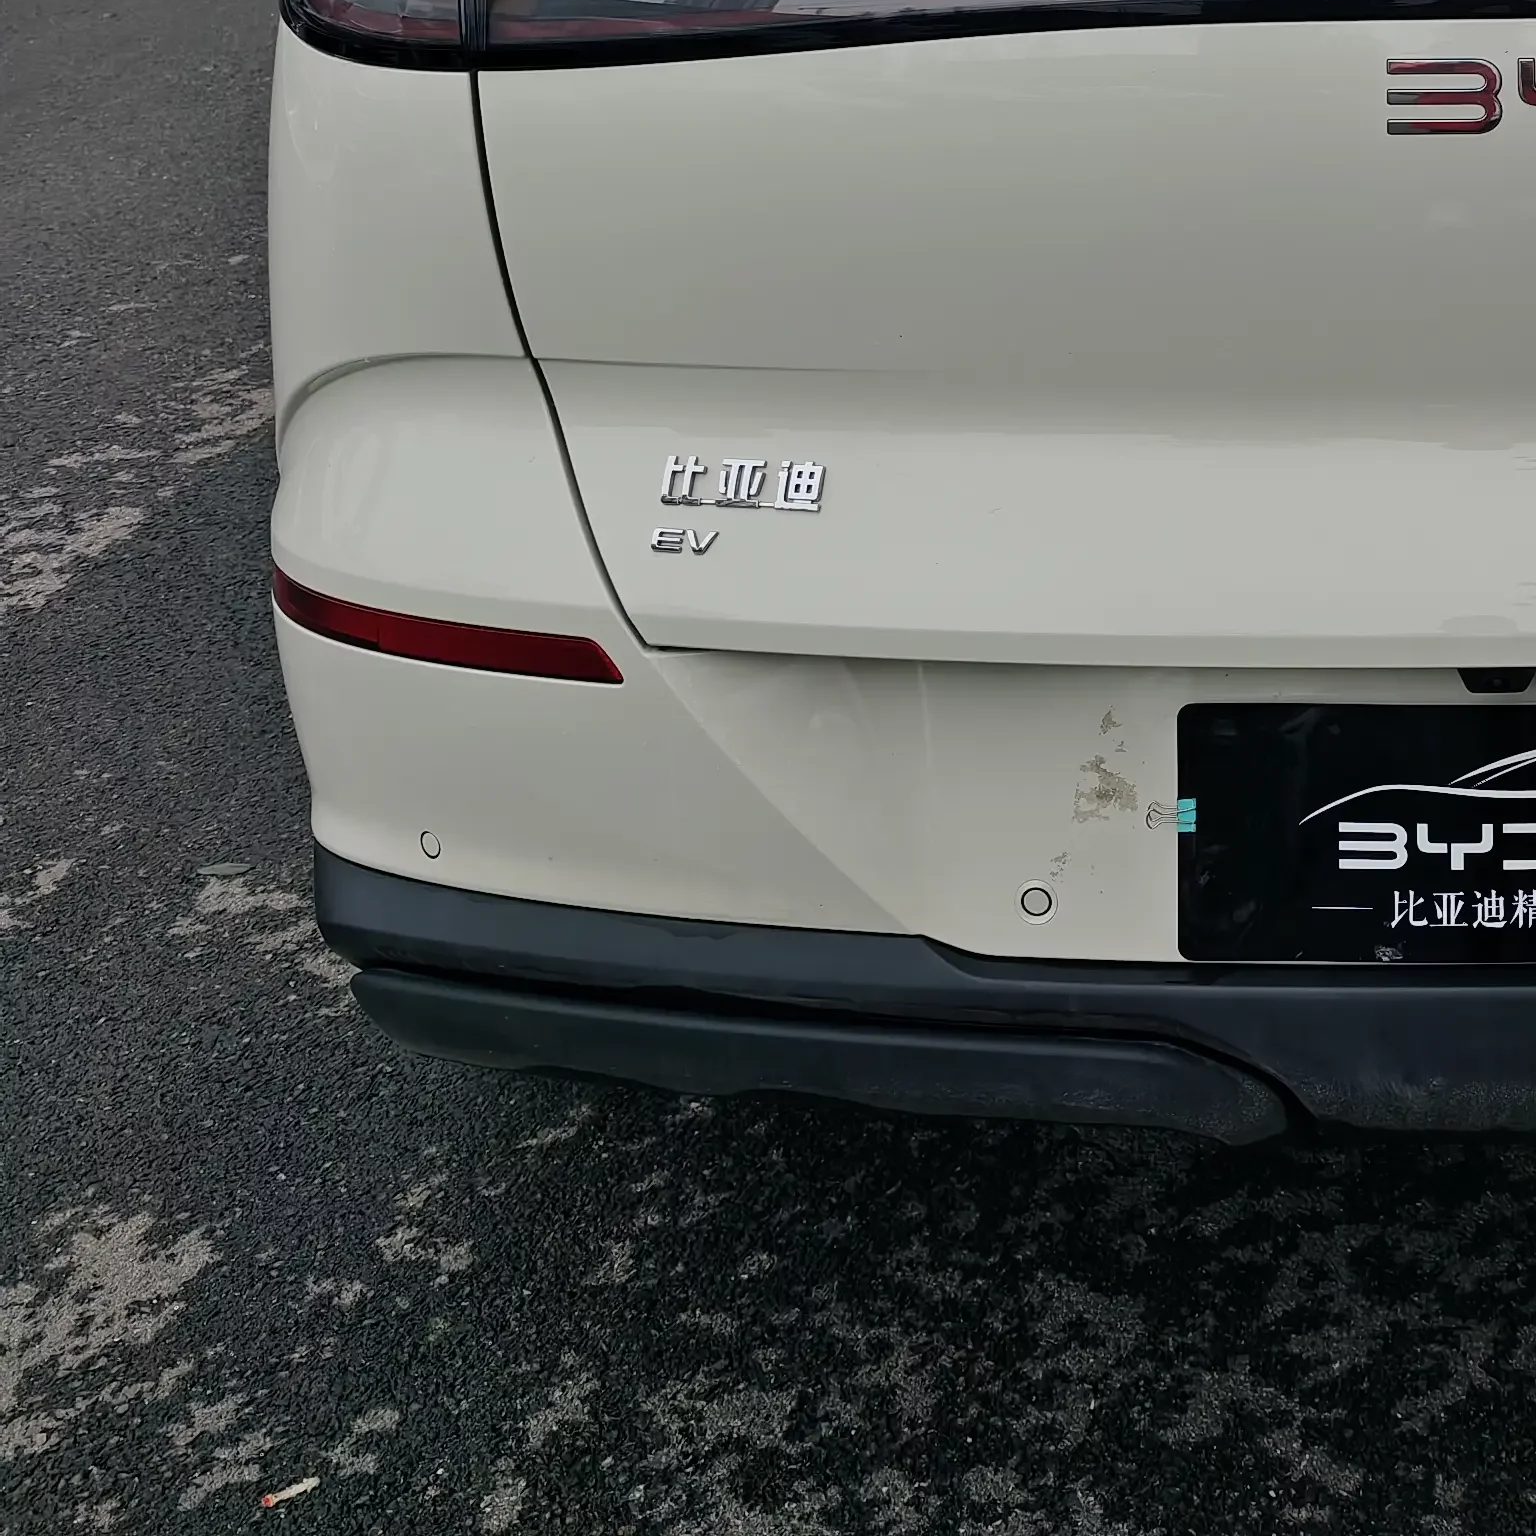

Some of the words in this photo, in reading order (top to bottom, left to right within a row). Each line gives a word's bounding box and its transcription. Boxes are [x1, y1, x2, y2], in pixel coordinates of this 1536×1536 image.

[660, 455, 826, 513] 比亚迪
[650, 526, 720, 555] EV
